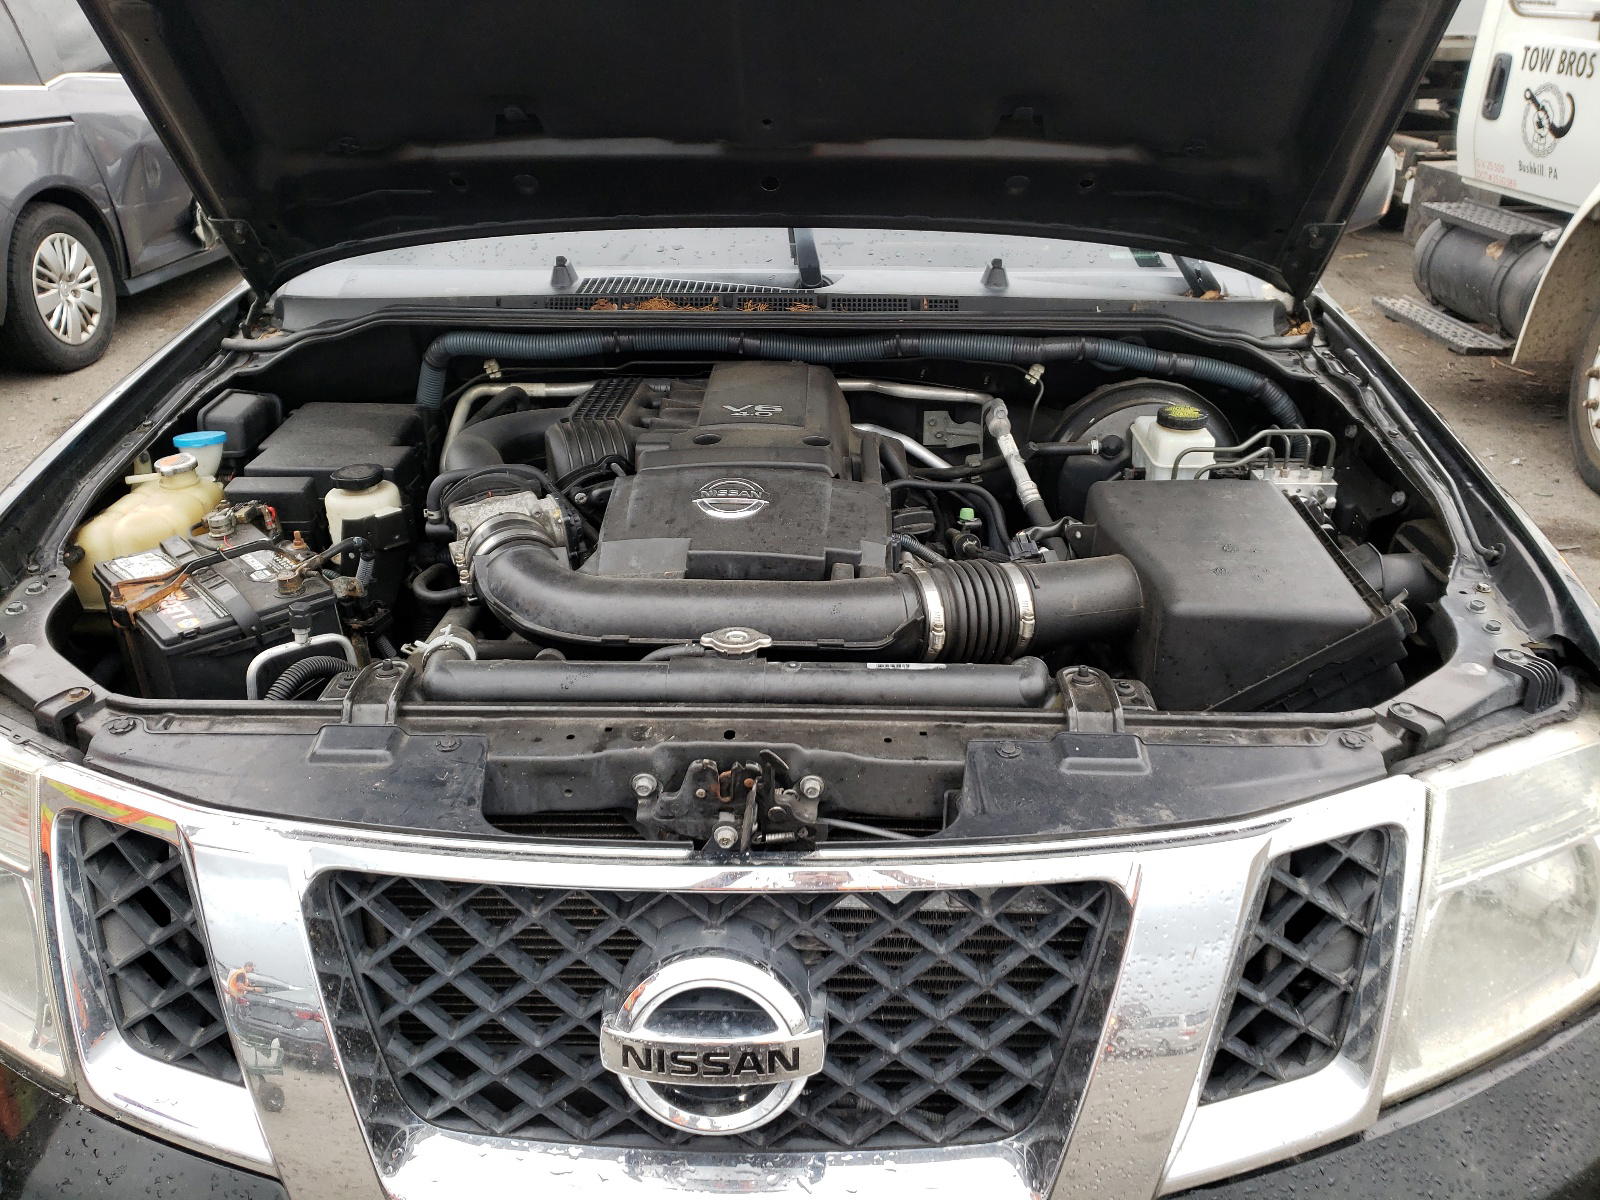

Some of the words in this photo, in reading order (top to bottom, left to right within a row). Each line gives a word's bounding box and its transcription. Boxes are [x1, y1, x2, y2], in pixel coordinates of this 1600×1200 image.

[1521, 45, 1555, 73] TOW
[1556, 49, 1597, 79] BROS
[1548, 166, 1558, 180] PA
[722, 404, 783, 412] V6
[700, 489, 763, 499] NISSAN
[621, 1045, 800, 1077] NISSAN
